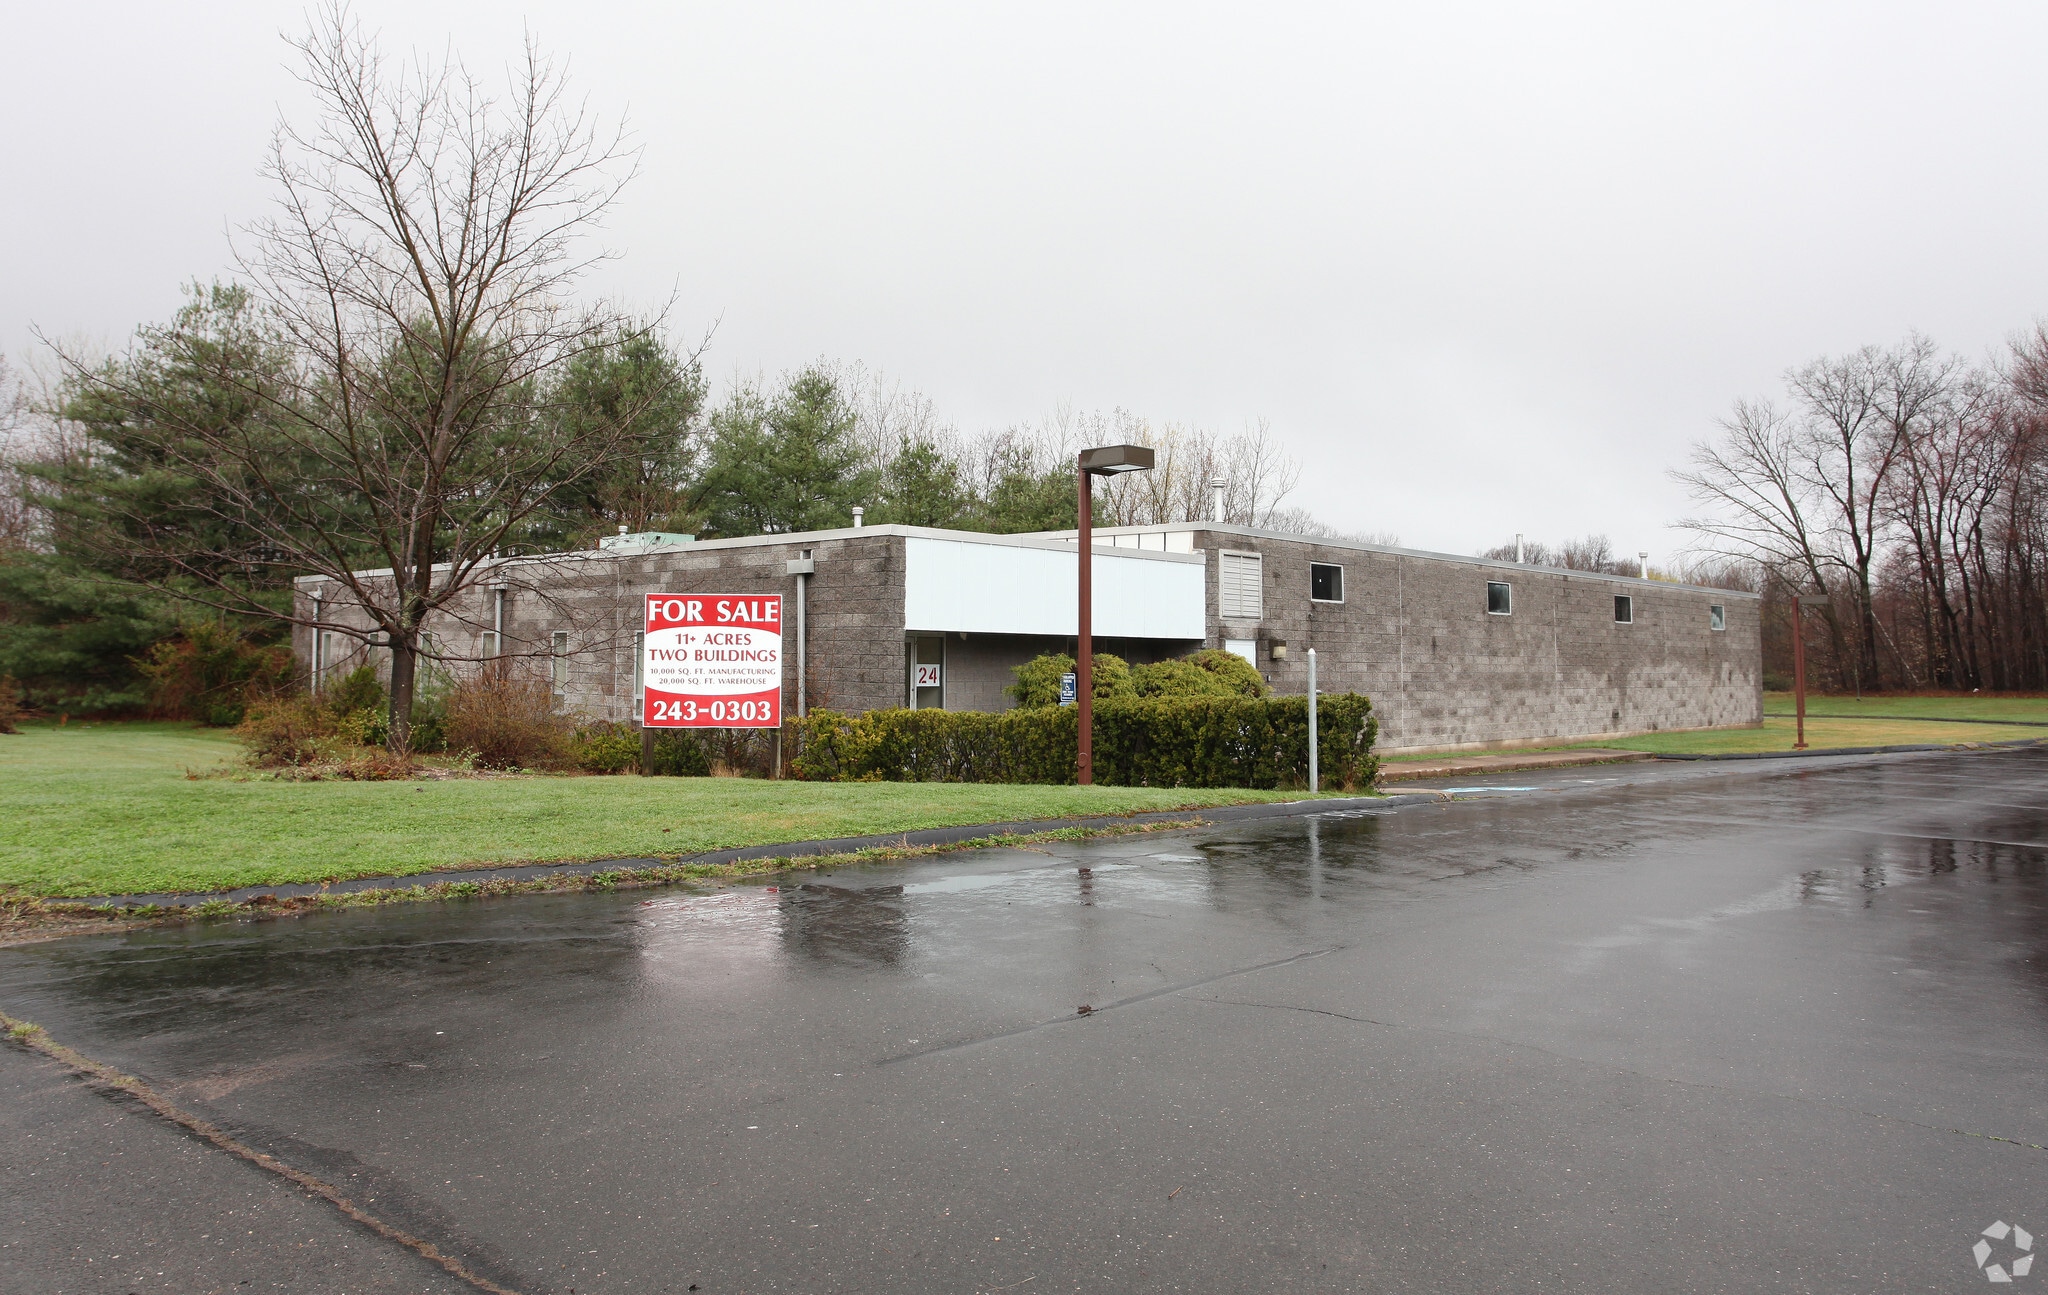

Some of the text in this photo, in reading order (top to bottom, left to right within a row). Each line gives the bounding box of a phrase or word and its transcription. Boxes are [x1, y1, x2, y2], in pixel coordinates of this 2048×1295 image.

[648, 599, 778, 622] FOR SALE
[703, 633, 752, 645] ACRES
[649, 649, 777, 662] TWO BUILDINGS
[678, 668, 692, 676] SQ.
[918, 667, 937, 684] 24
[652, 700, 772, 721] 243-0303
